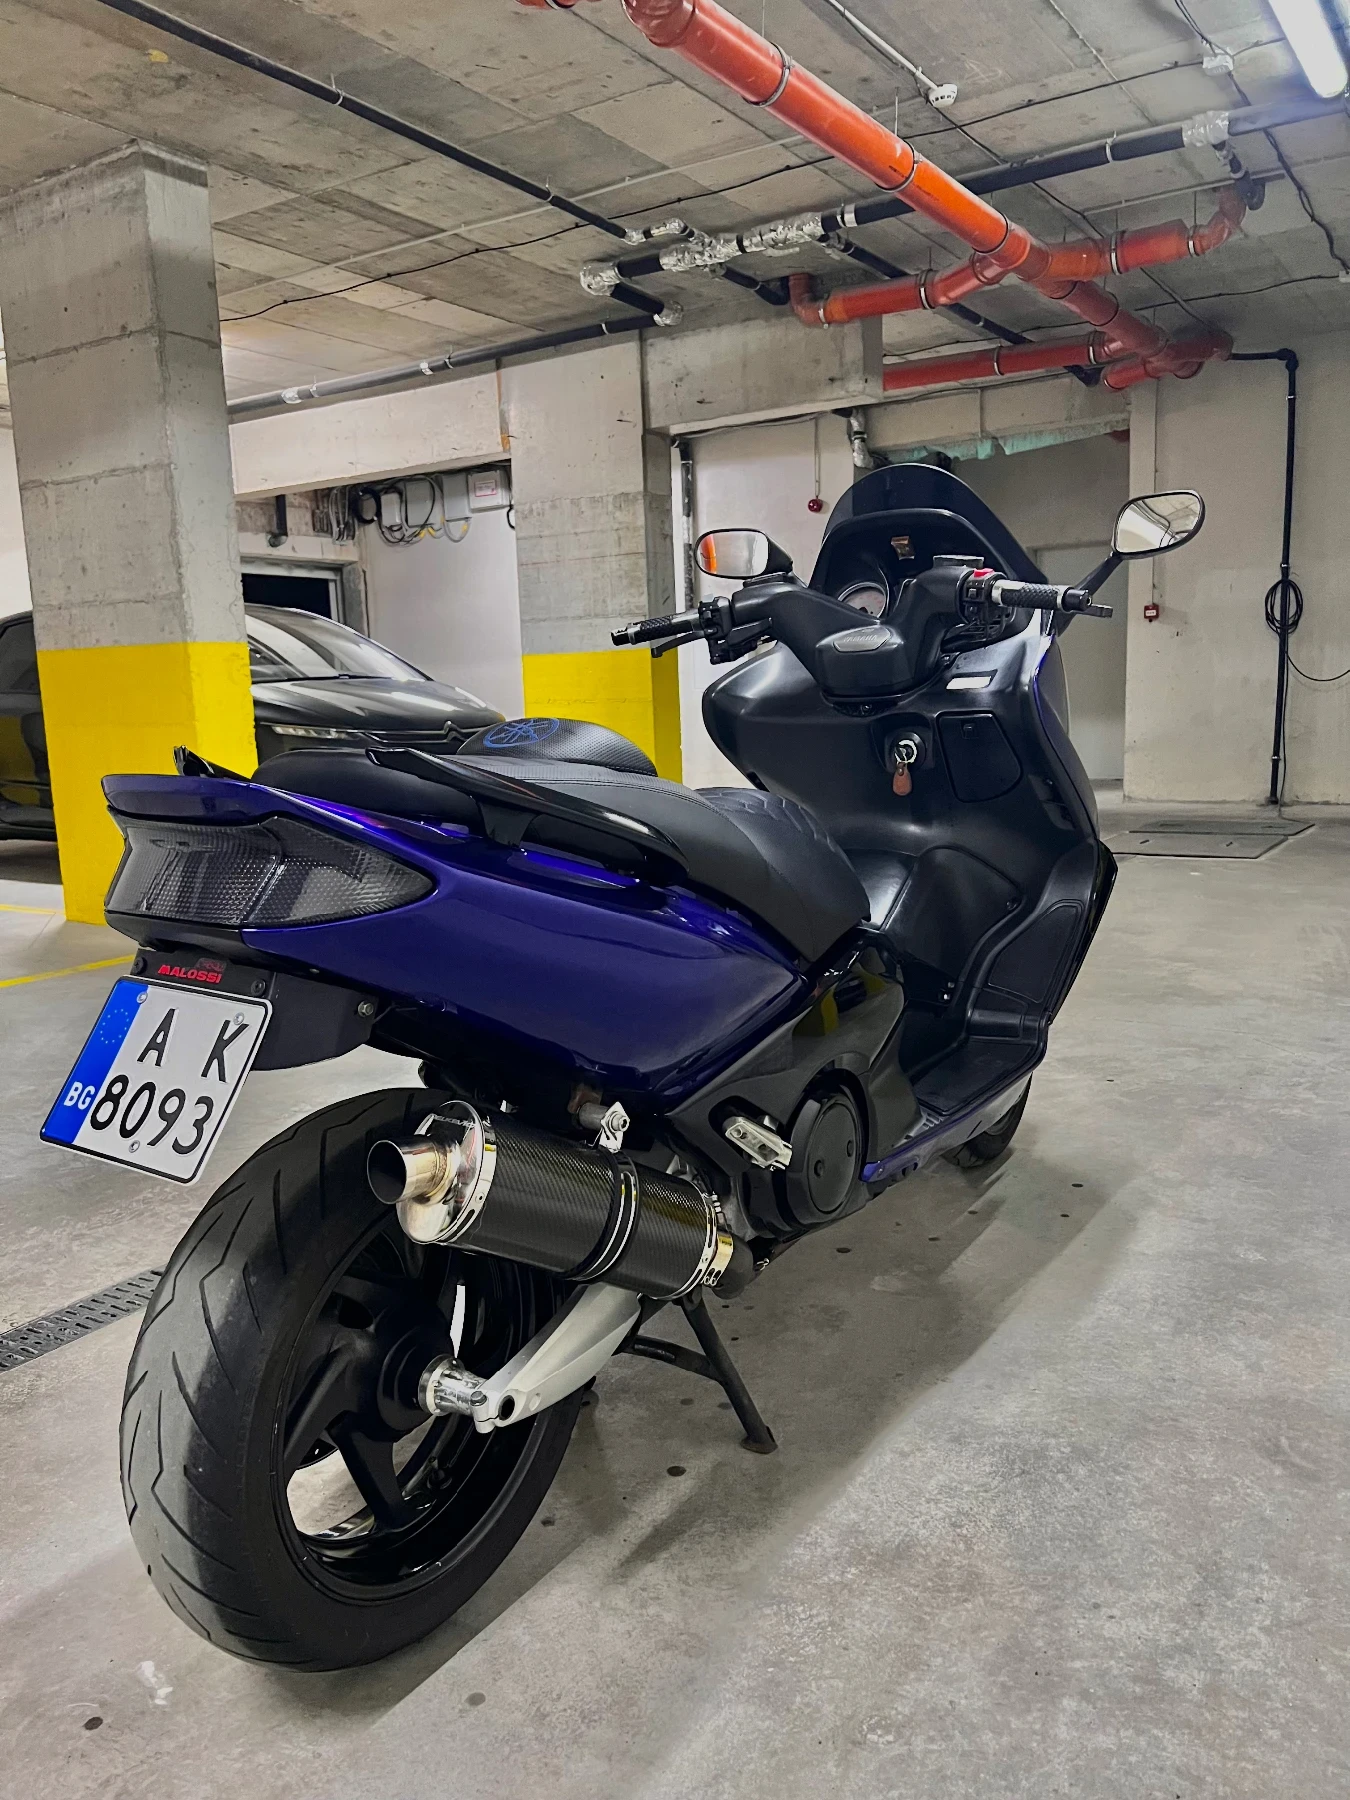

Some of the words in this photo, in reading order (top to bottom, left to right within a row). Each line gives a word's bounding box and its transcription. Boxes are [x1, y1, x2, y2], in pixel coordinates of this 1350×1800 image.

[157, 965, 222, 983] MALOSSI
[137, 1008, 174, 1067] A
[201, 1020, 249, 1083] K
[63, 1081, 95, 1110] BG
[90, 1074, 214, 1155] 8093
